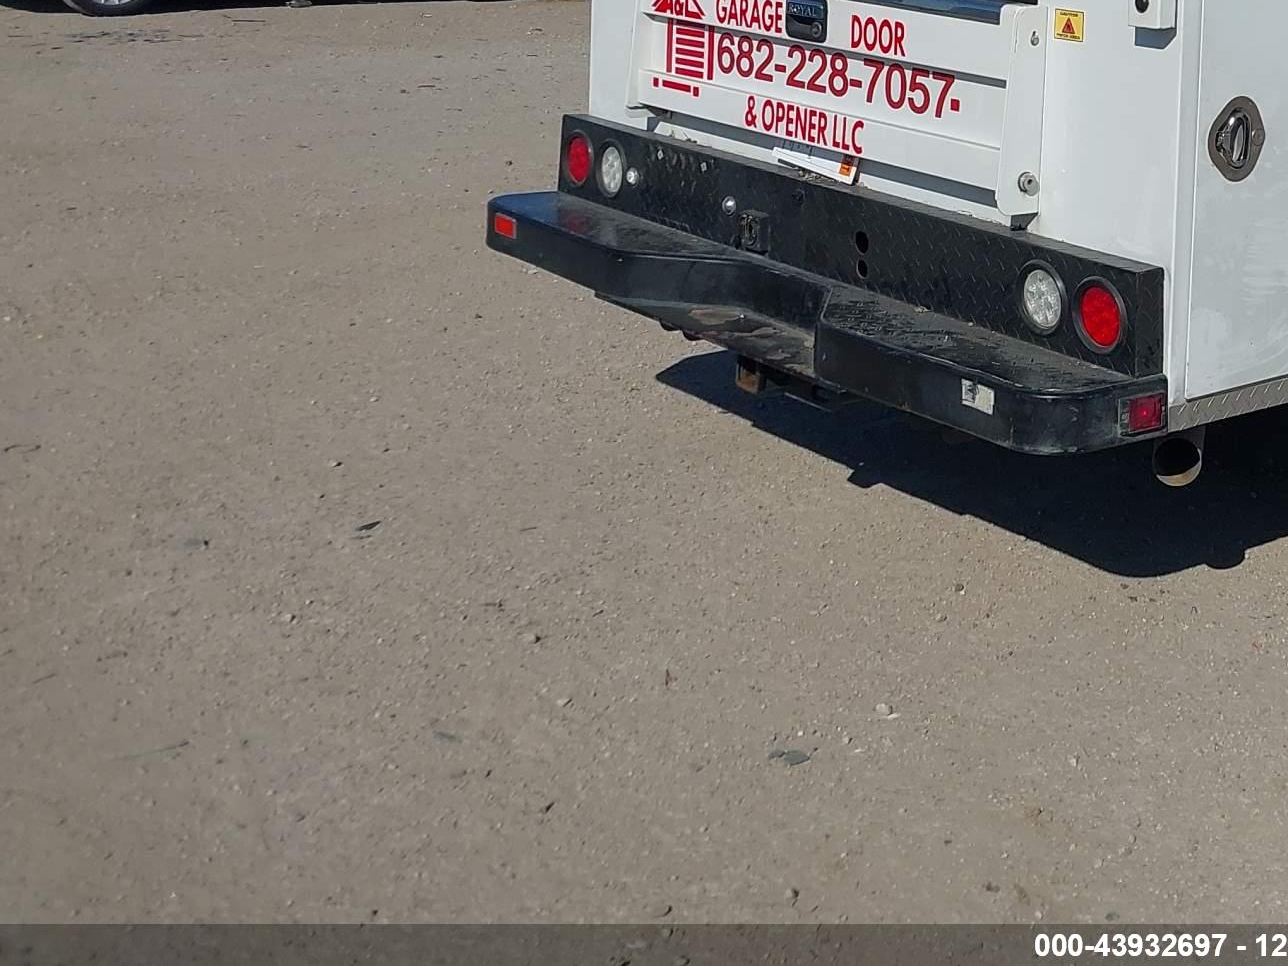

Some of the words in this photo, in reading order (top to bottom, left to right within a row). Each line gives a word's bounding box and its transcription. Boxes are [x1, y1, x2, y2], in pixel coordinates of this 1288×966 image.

[788, 4, 817, 17] ROYAL
[850, 14, 906, 57] DOOR
[717, 33, 956, 118] 682-228-7057
[744, 95, 757, 128] &
[761, 99, 828, 146] OPENER
[831, 116, 865, 155] LLC
